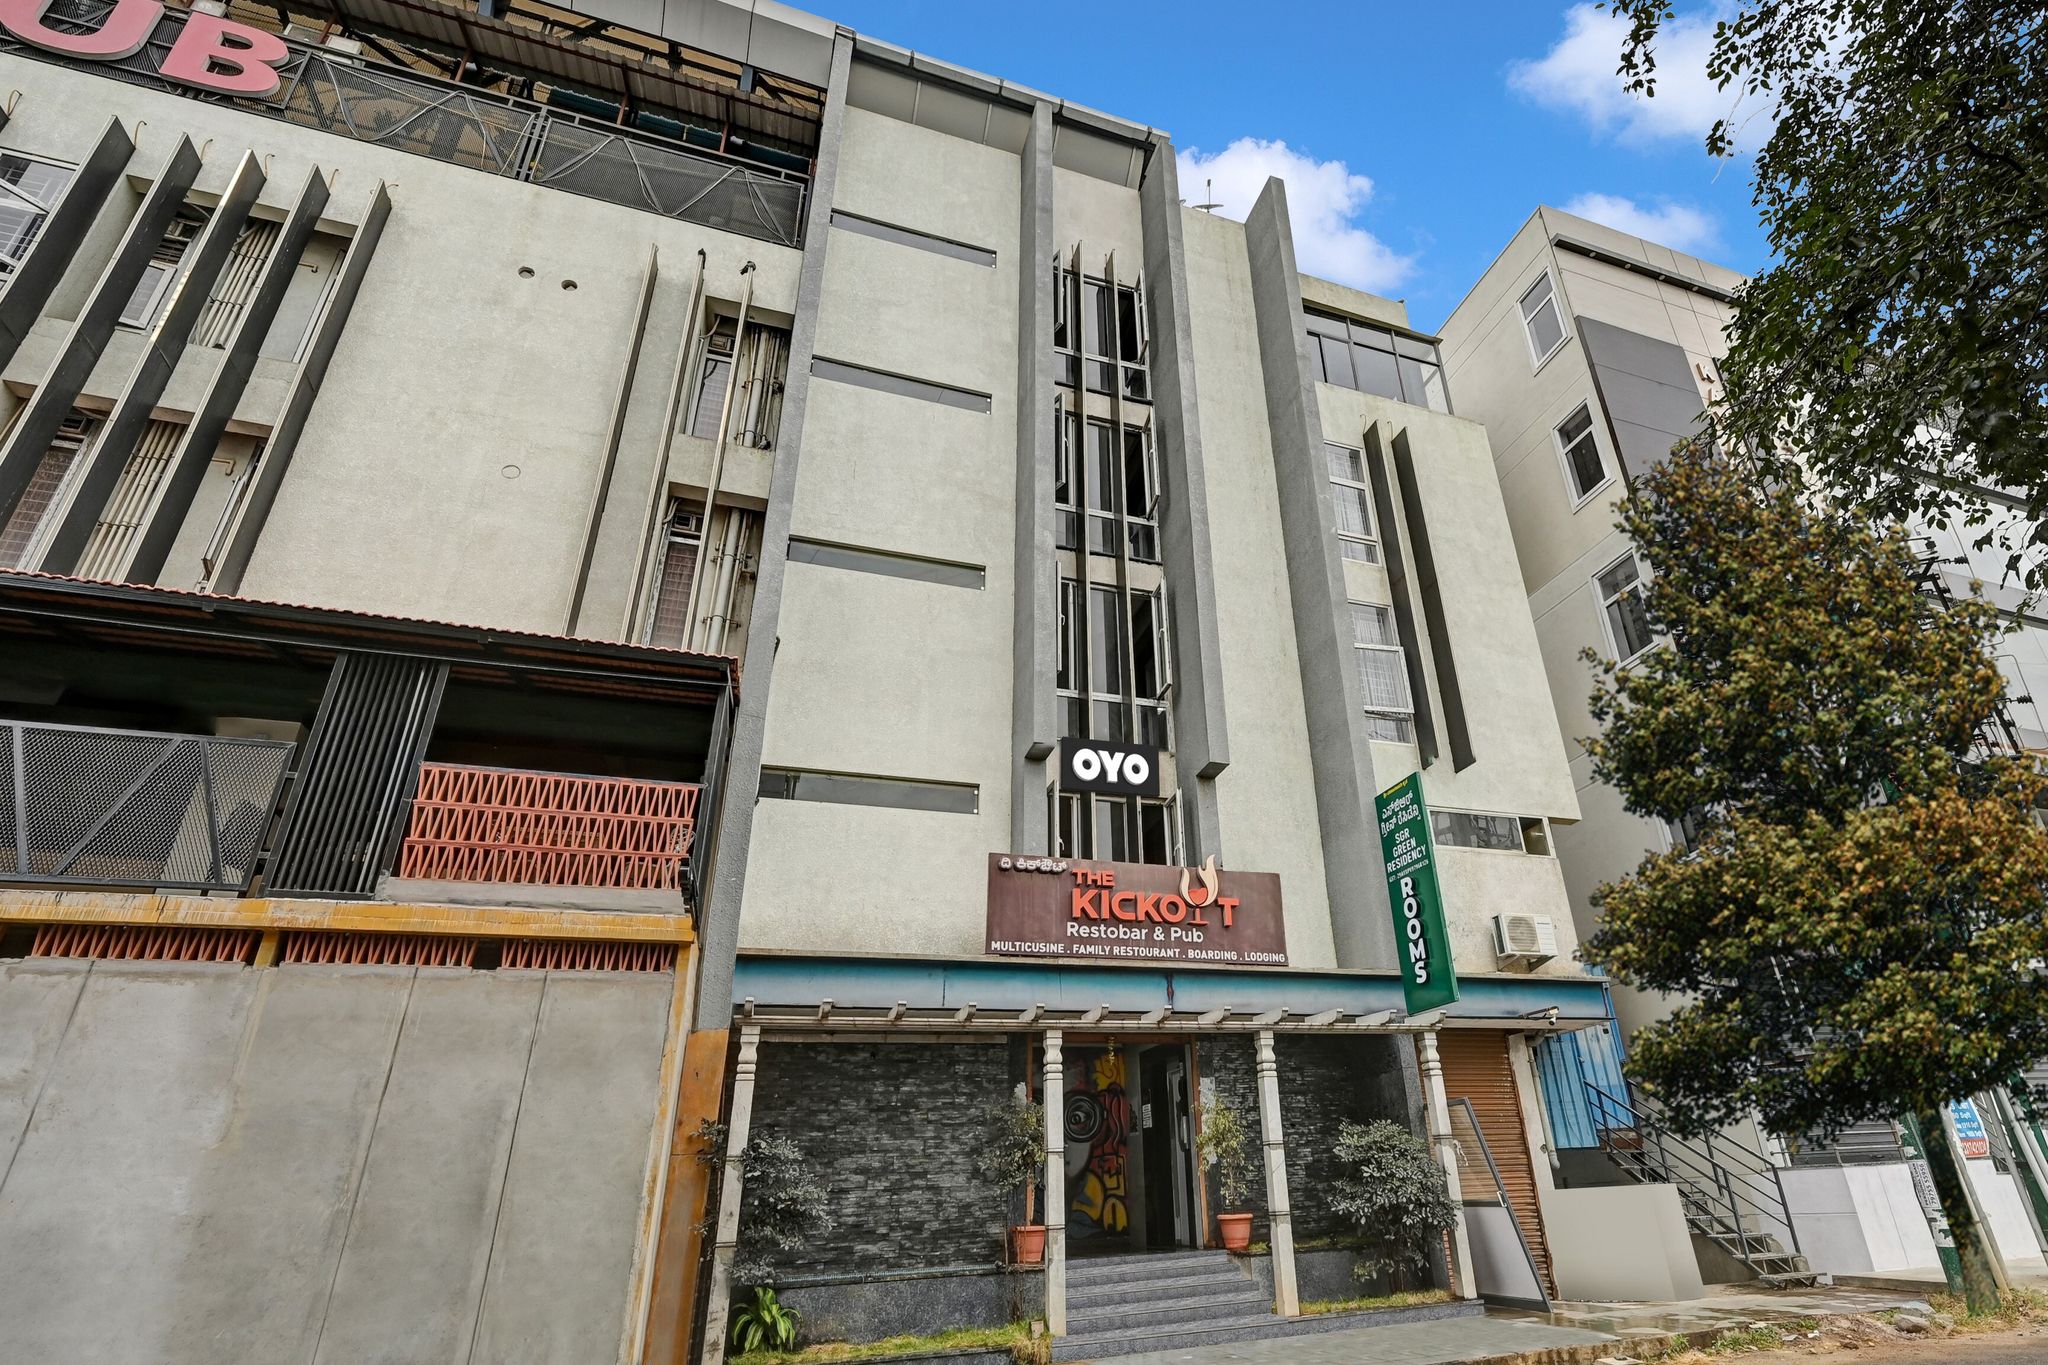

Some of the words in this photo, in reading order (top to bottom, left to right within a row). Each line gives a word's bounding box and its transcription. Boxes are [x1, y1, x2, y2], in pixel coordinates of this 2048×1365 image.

[1072, 748, 1149, 785] OYO
[1395, 828, 1410, 843] SGR
[1392, 837, 1416, 857] GREEN
[1386, 844, 1426, 873] RESIDENCY
[1072, 868, 1115, 887] THE
[1066, 921, 1149, 941] Restobar
[1153, 927, 1165, 941] &
[1170, 927, 1204, 943] Pub
[1400, 876, 1427, 984] ROOMS
[991, 941, 1064, 953] MULTICUSINE
[1073, 944, 1111, 955] FAMILY
[1113, 946, 1180, 958] RESTOURANT
[1188, 949, 1237, 960] BOARDING
[1245, 953, 1285, 962] LODGING
